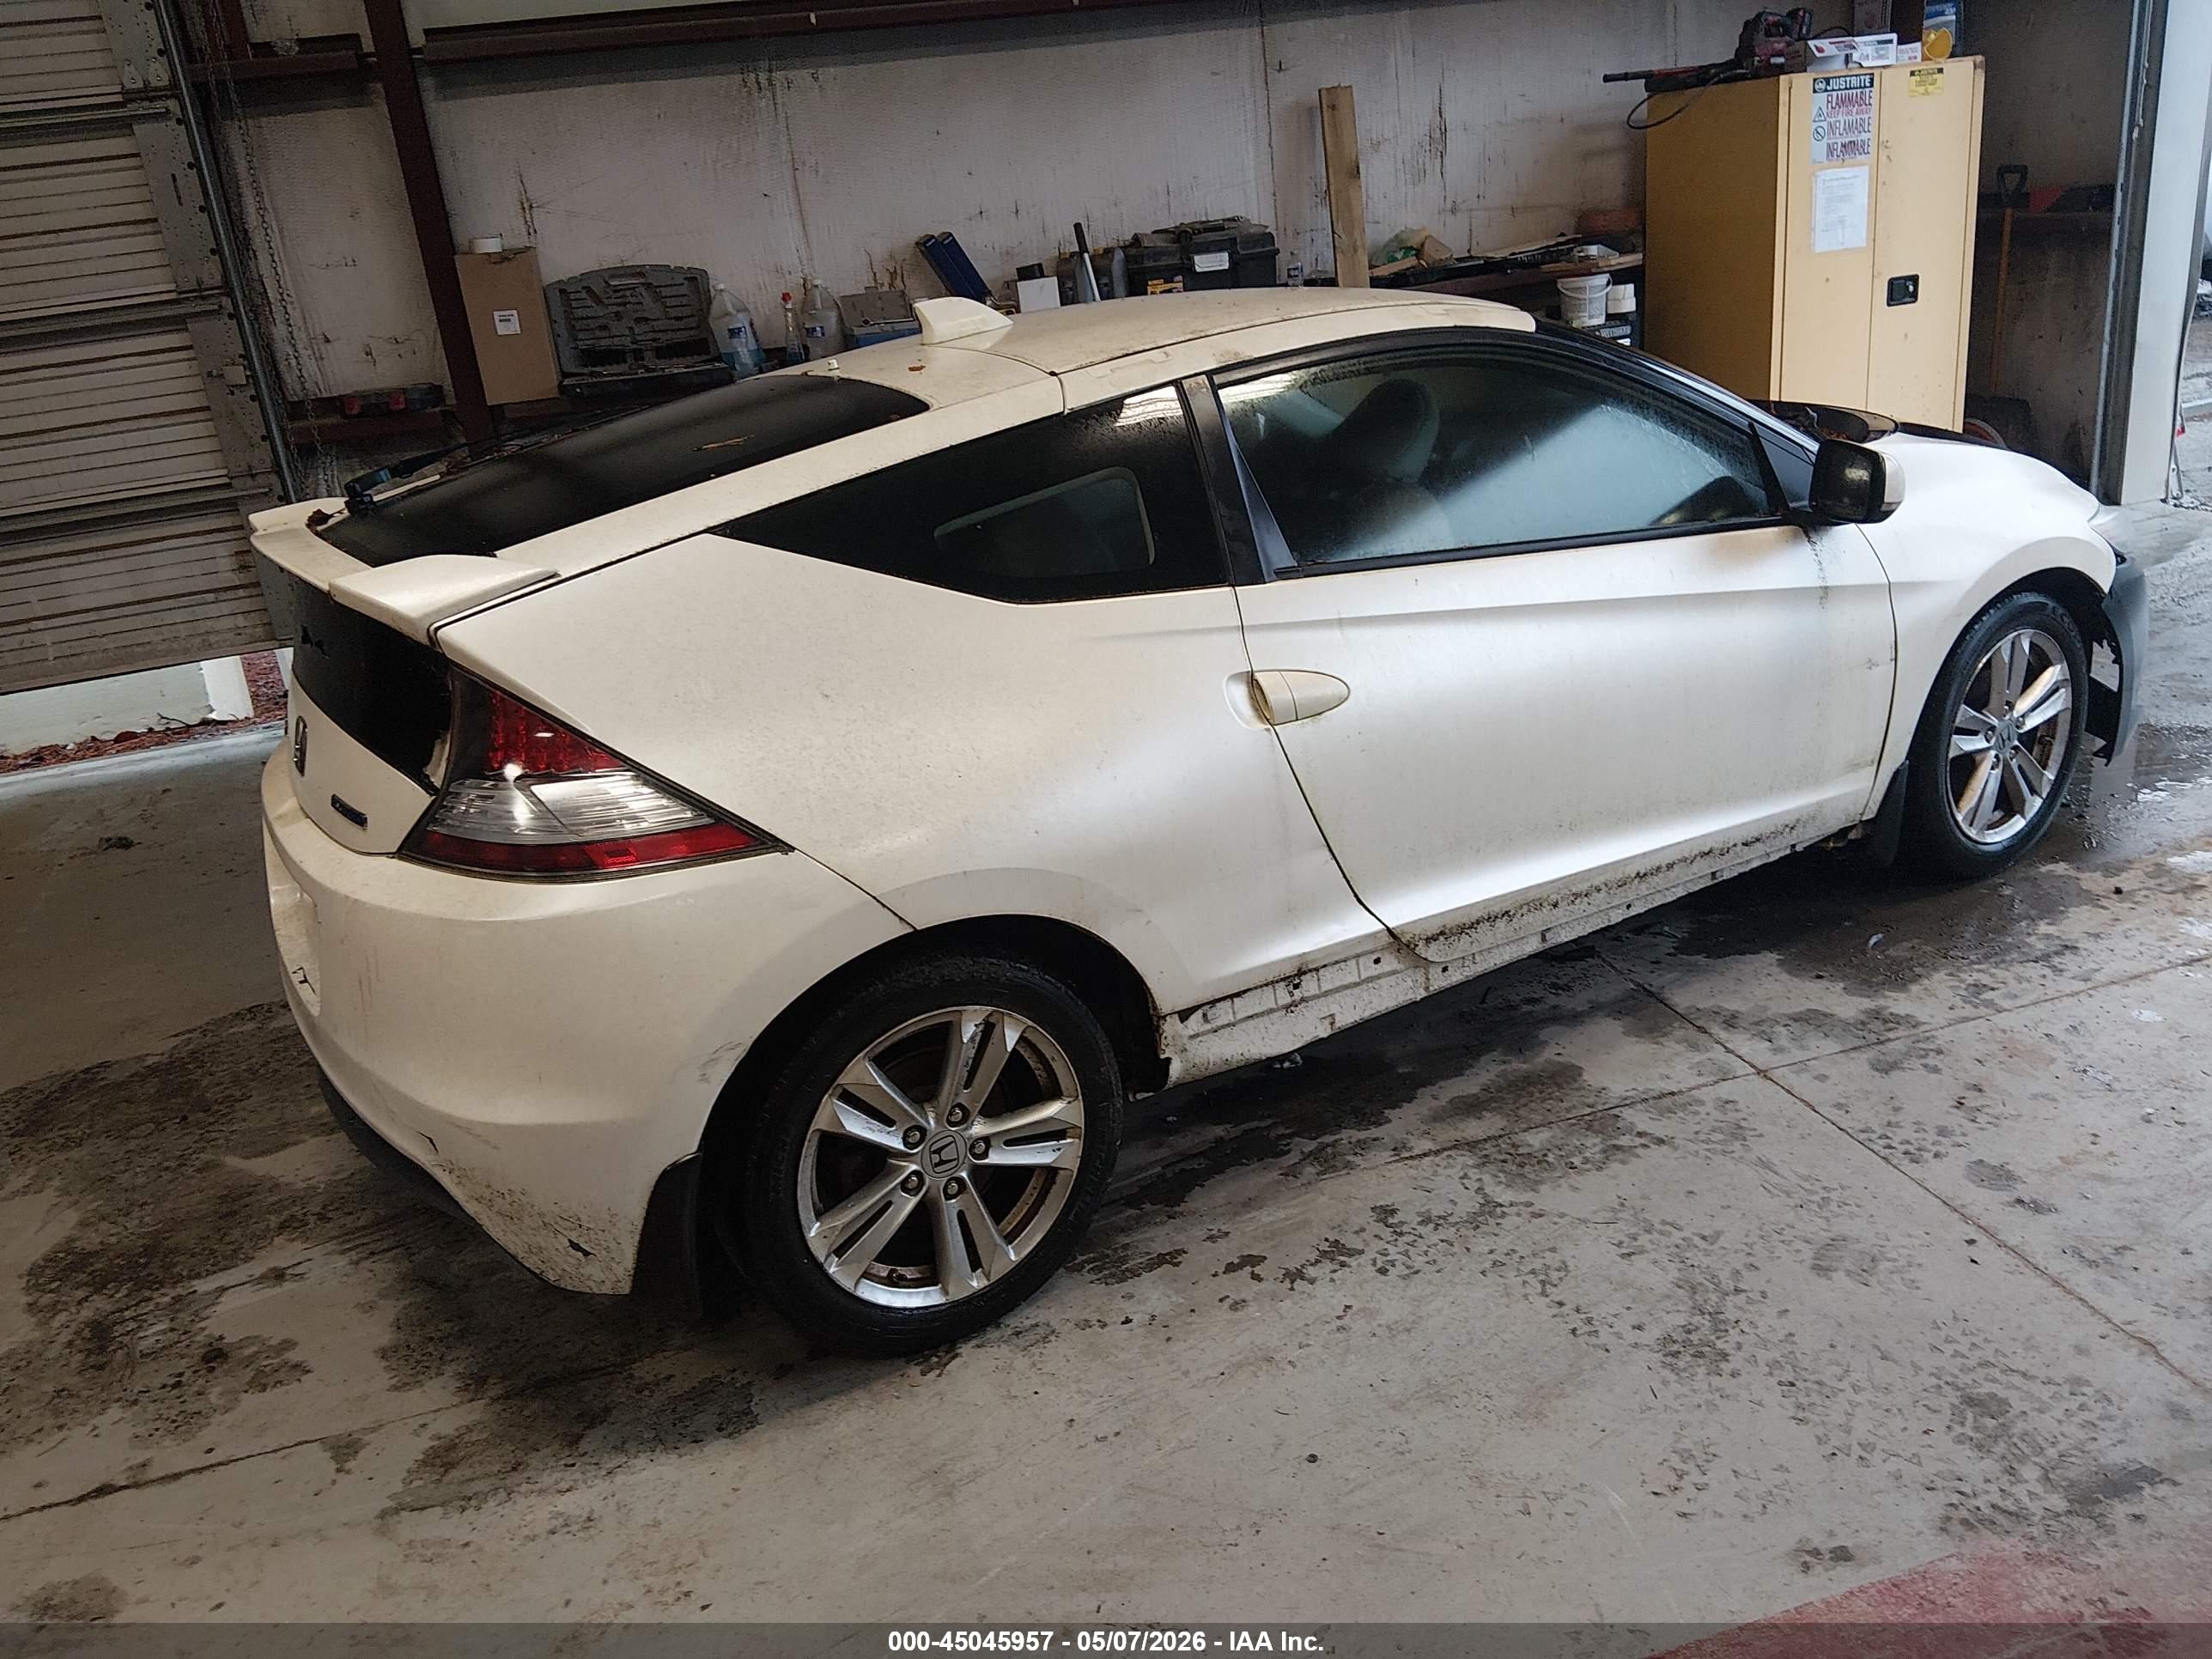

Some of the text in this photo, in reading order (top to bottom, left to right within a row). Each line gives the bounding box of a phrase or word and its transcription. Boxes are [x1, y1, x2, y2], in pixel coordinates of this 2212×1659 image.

[1826, 75, 1872, 91] JUSTRITE
[1826, 90, 1873, 110] FLAMMABLE
[1826, 117, 1872, 137] INFLAMABLE
